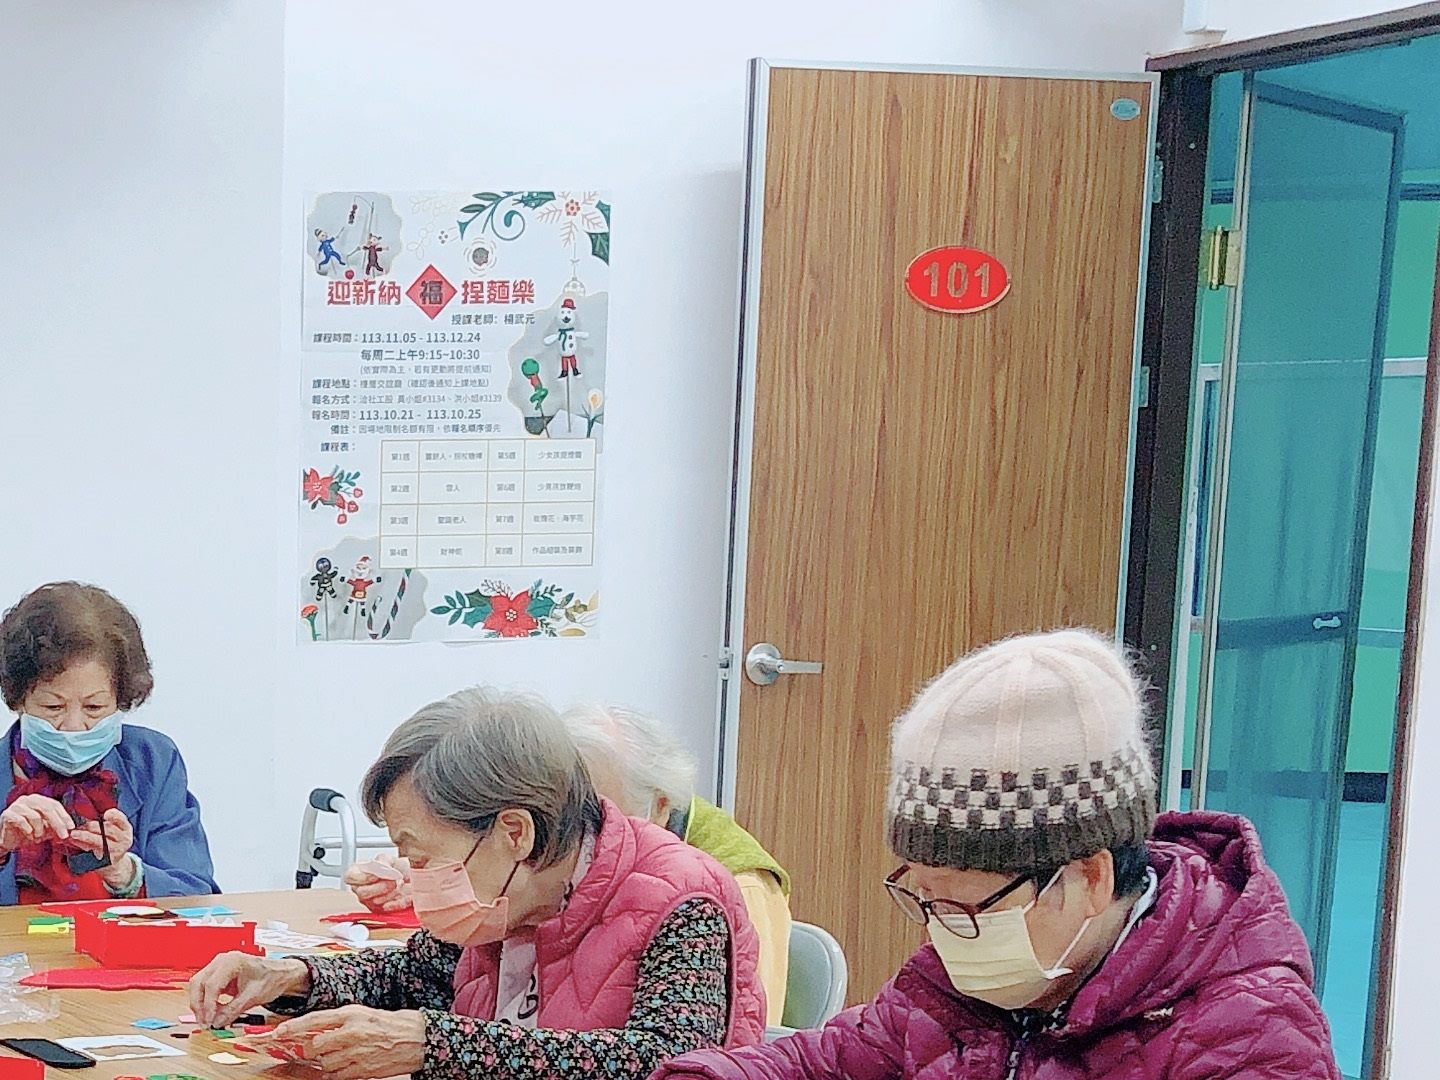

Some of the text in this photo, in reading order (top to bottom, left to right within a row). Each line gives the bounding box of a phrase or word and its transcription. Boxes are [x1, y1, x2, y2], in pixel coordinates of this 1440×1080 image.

[923, 261, 990, 298] 101
[327, 278, 534, 305] 迎新納 福 捏麵樂
[425, 332, 481, 344] 113.12.24
[426, 408, 482, 420] 113.10.25
